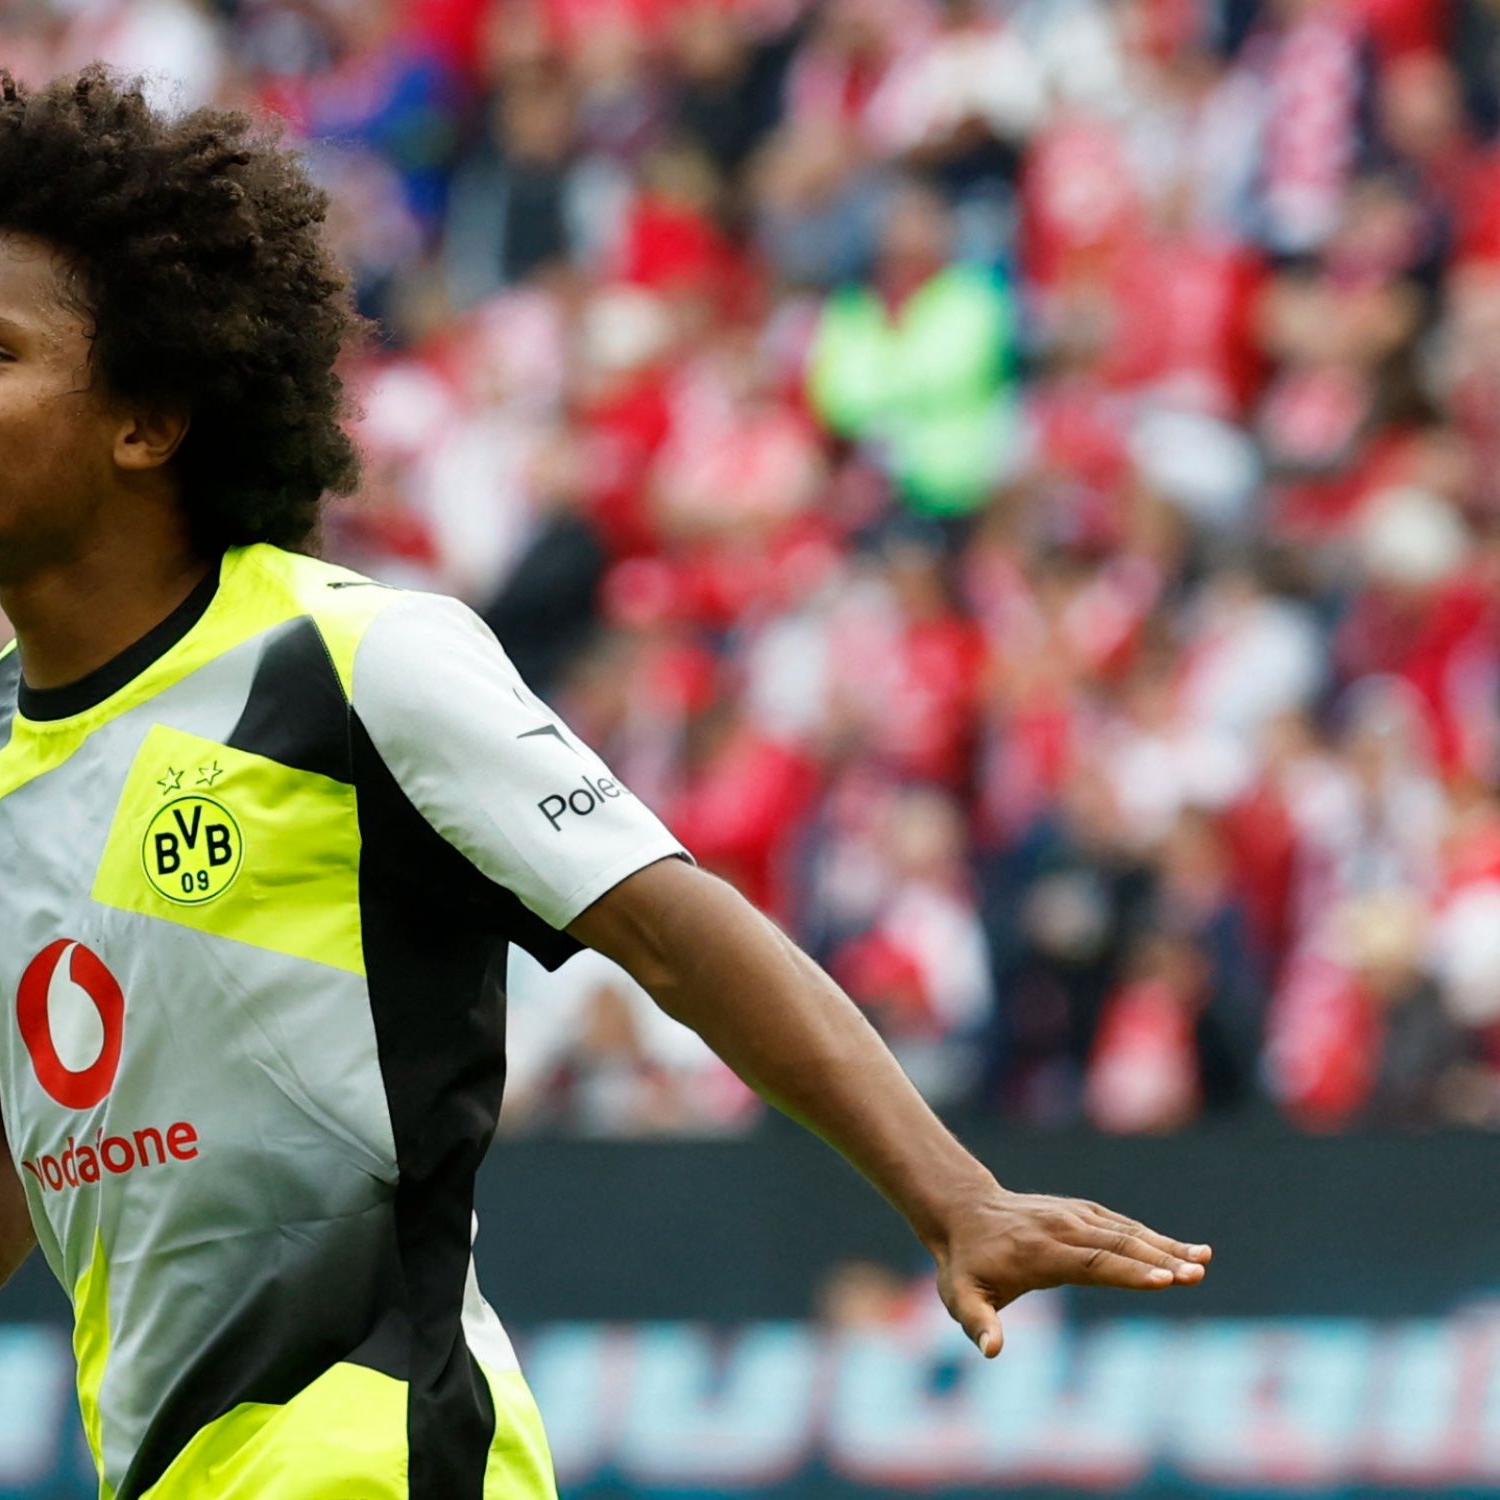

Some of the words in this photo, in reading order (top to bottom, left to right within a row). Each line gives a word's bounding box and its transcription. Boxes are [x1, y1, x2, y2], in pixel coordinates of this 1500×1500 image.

[154, 805, 232, 876] BVB
[181, 869, 209, 893] 09
[21, 1121, 199, 1192] vodaone
